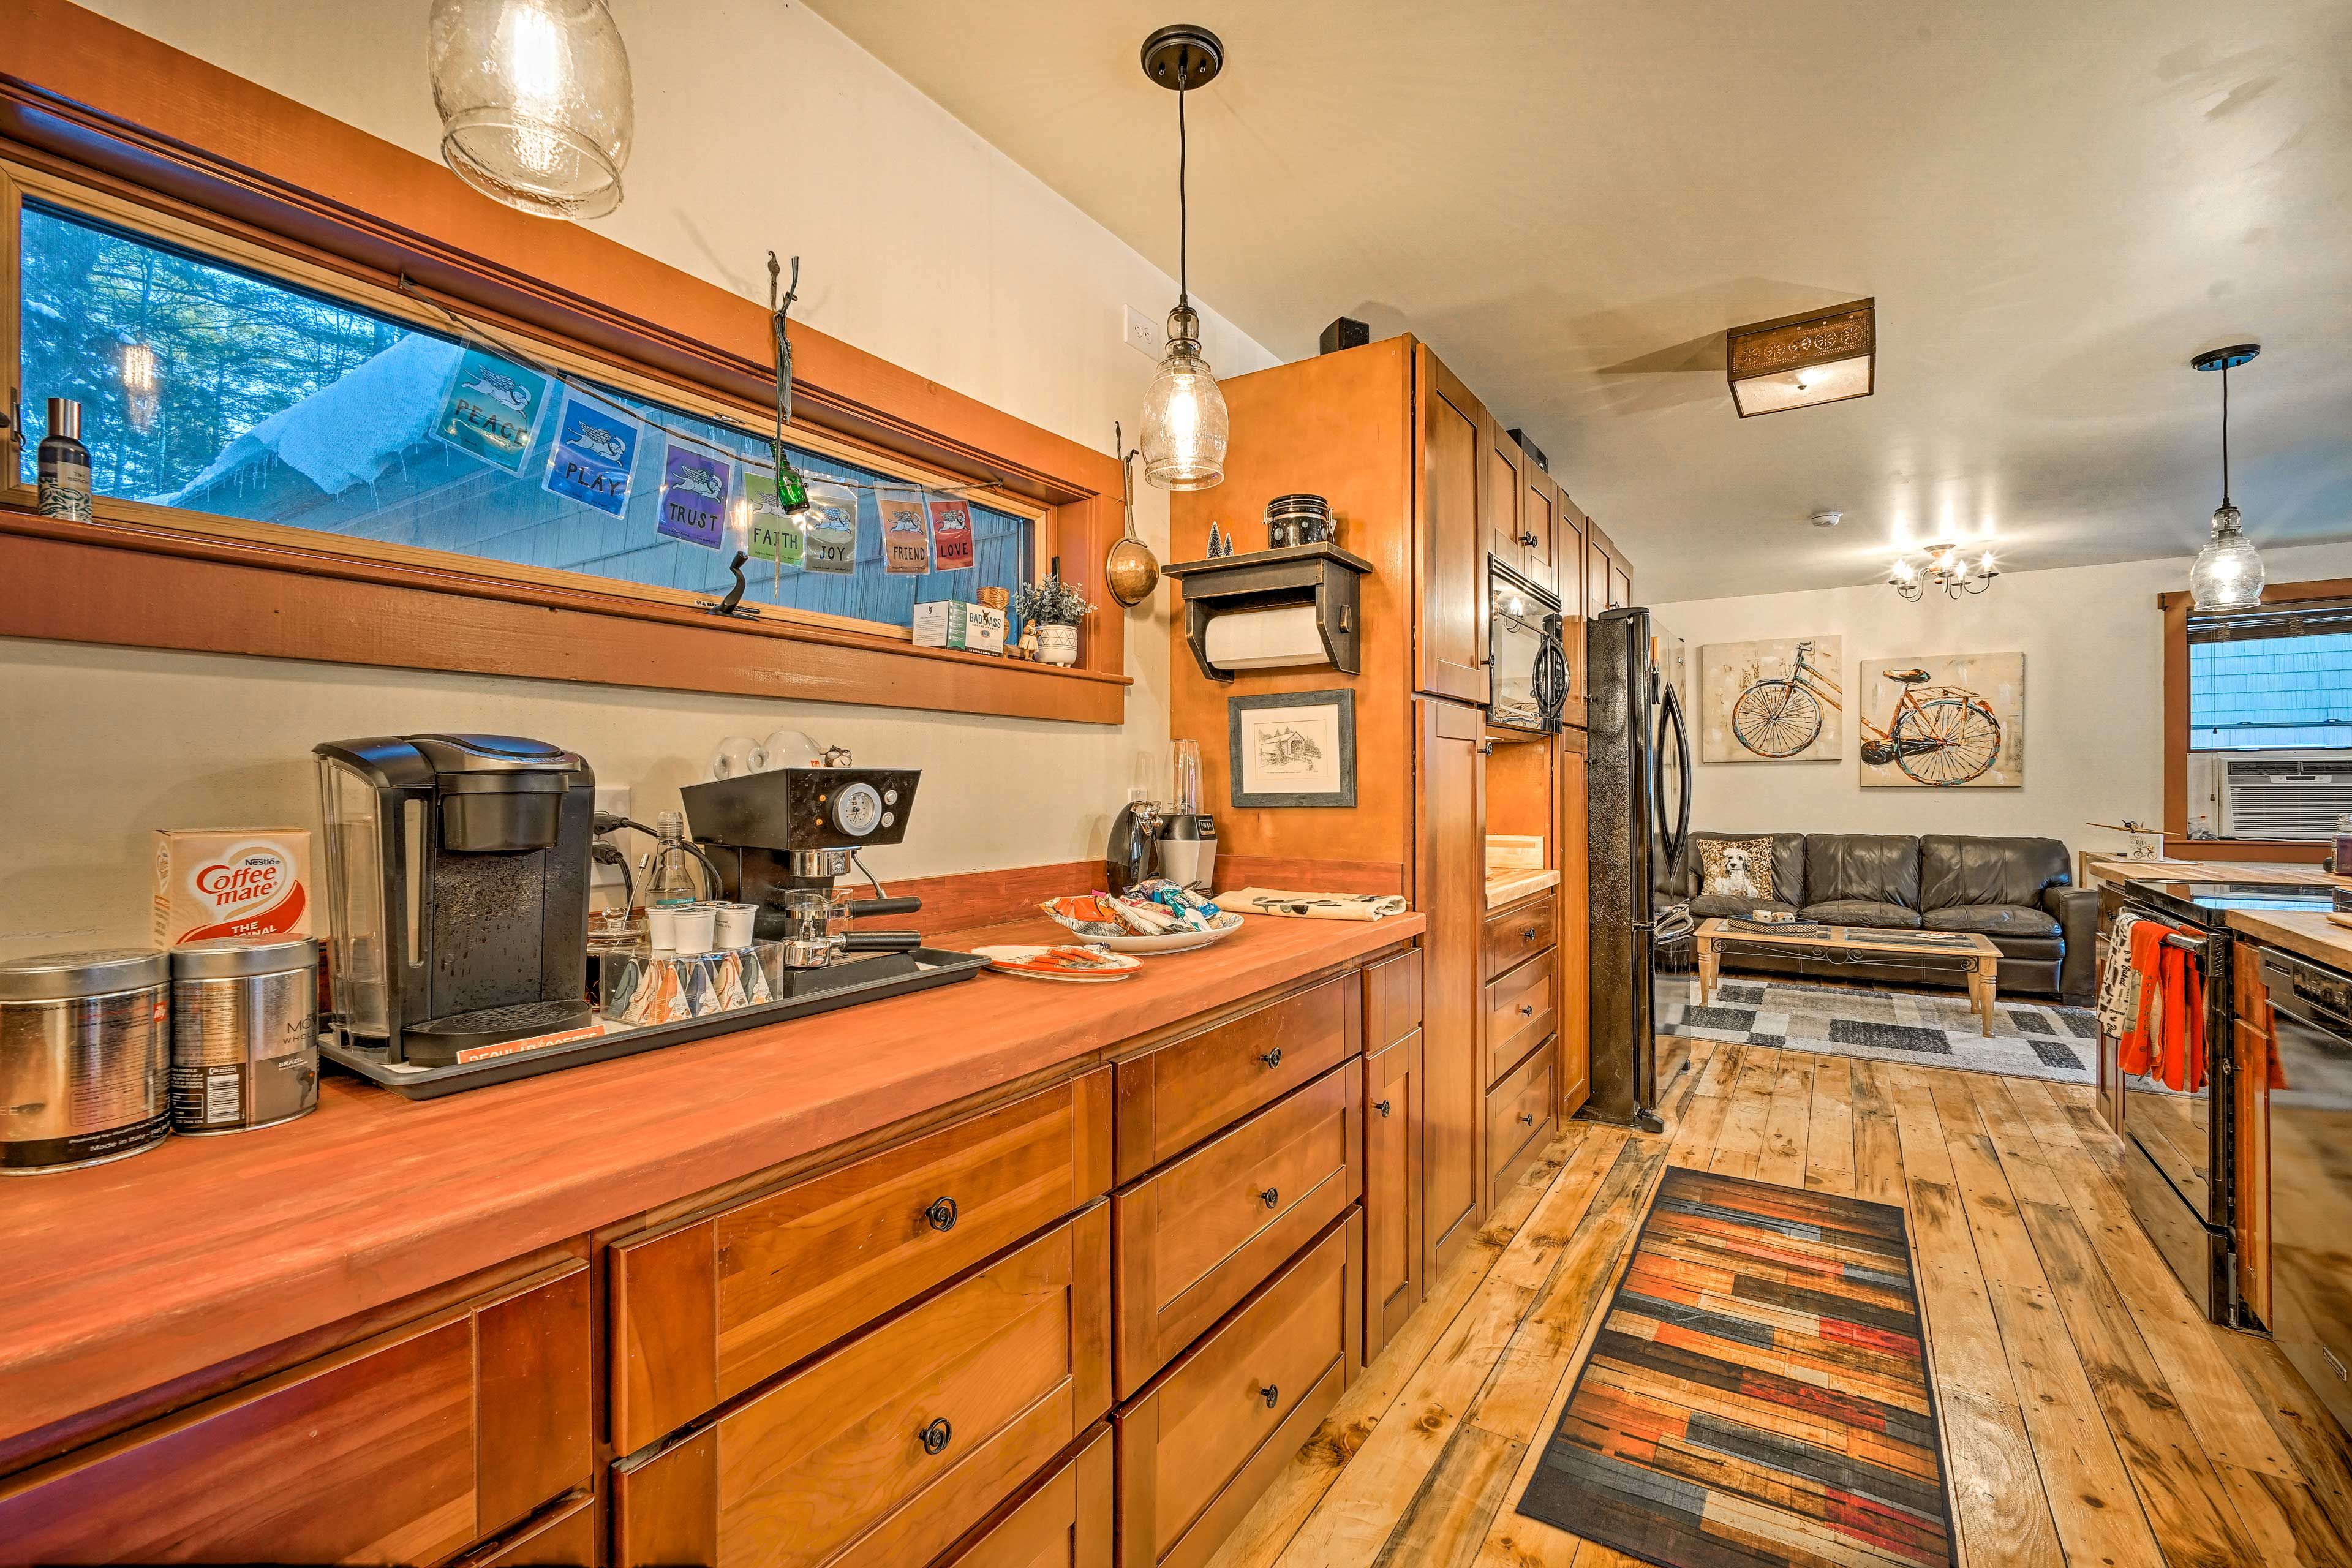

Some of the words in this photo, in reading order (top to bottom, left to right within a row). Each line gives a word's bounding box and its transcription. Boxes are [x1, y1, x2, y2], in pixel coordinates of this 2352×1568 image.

[455, 399, 529, 447] PEACE
[565, 462, 620, 496] PLAY
[669, 503, 718, 532] TRUST
[754, 527, 797, 549] FAITH
[819, 545, 845, 562] JOY
[893, 546, 925, 560] FRIEND
[940, 543, 968, 557] LOVE
[970, 612, 982, 624] BAD
[989, 617, 1001, 628] ASS
[196, 865, 277, 894] Coffee
[216, 881, 272, 906] mate
[232, 921, 259, 933] THE
[2120, 965, 2132, 987] Baked
[154, 1005, 167, 1019] illy
[283, 1030, 315, 1044] WHOLE
[279, 1058, 303, 1068] BRAZIL
[89, 1142, 118, 1152] Made
[128, 1134, 146, 1143] Italy
